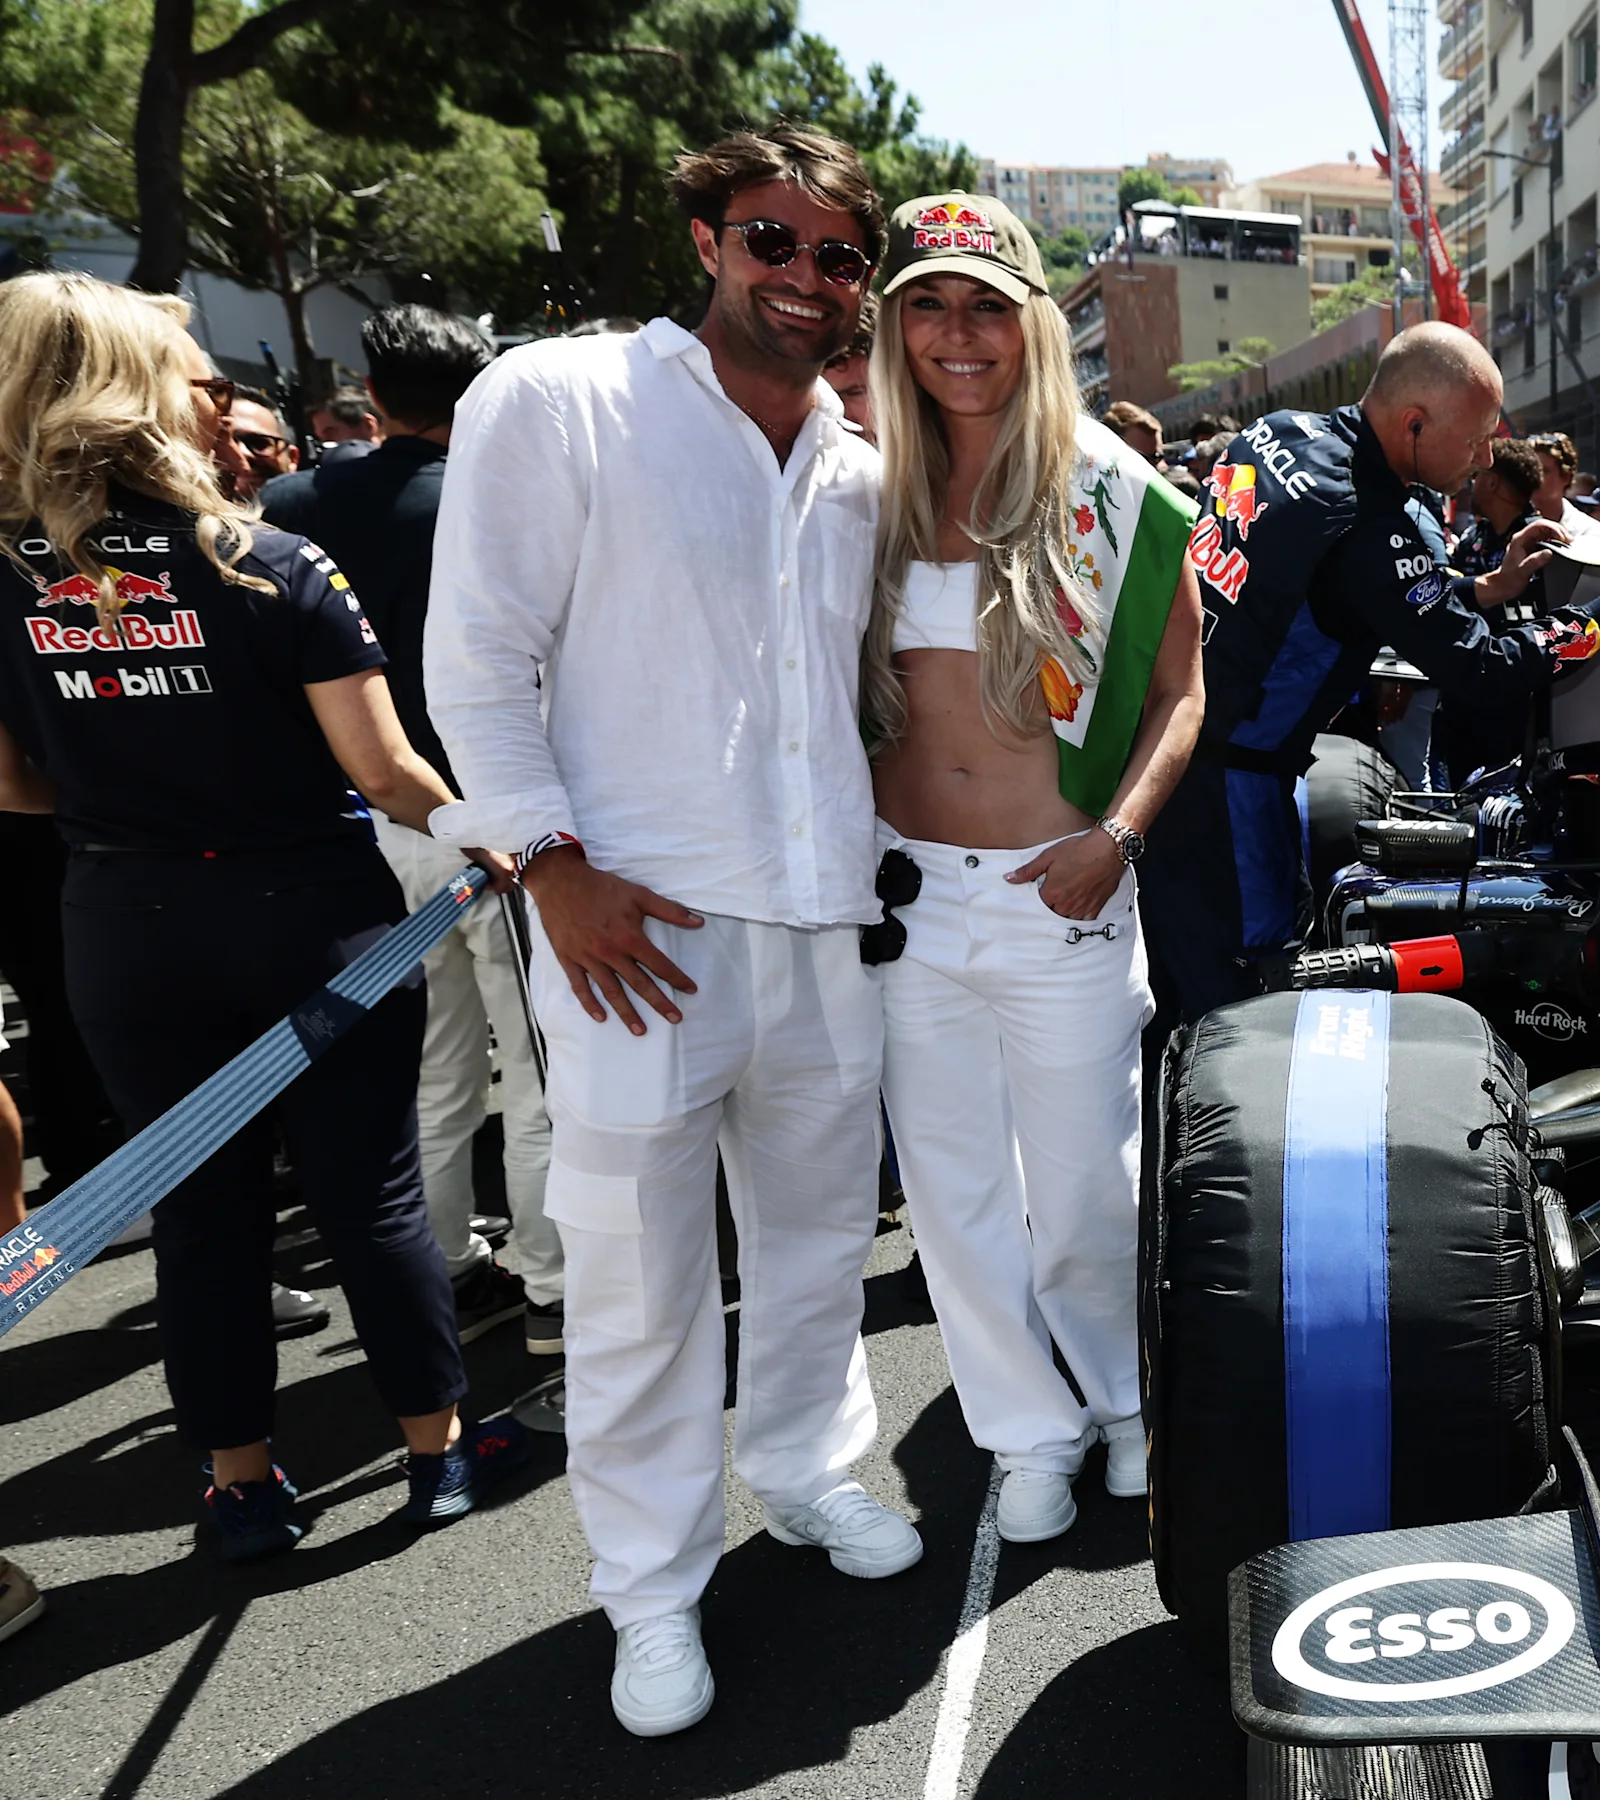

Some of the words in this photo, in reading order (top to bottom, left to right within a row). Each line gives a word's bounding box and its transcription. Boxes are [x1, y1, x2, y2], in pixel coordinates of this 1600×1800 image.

[913, 229, 953, 249] Red
[955, 231, 995, 254] Bull
[24, 617, 125, 653] Red
[119, 610, 206, 650] Bull
[54, 667, 170, 699] Mobil
[1309, 1004, 1341, 1056] Front
[1338, 1008, 1374, 1060] Right
[1514, 1010, 1550, 1027] Hard
[1552, 1011, 1587, 1034] Rock
[0, 1226, 43, 1271] RACLE
[15, 1262, 75, 1313] RACING
